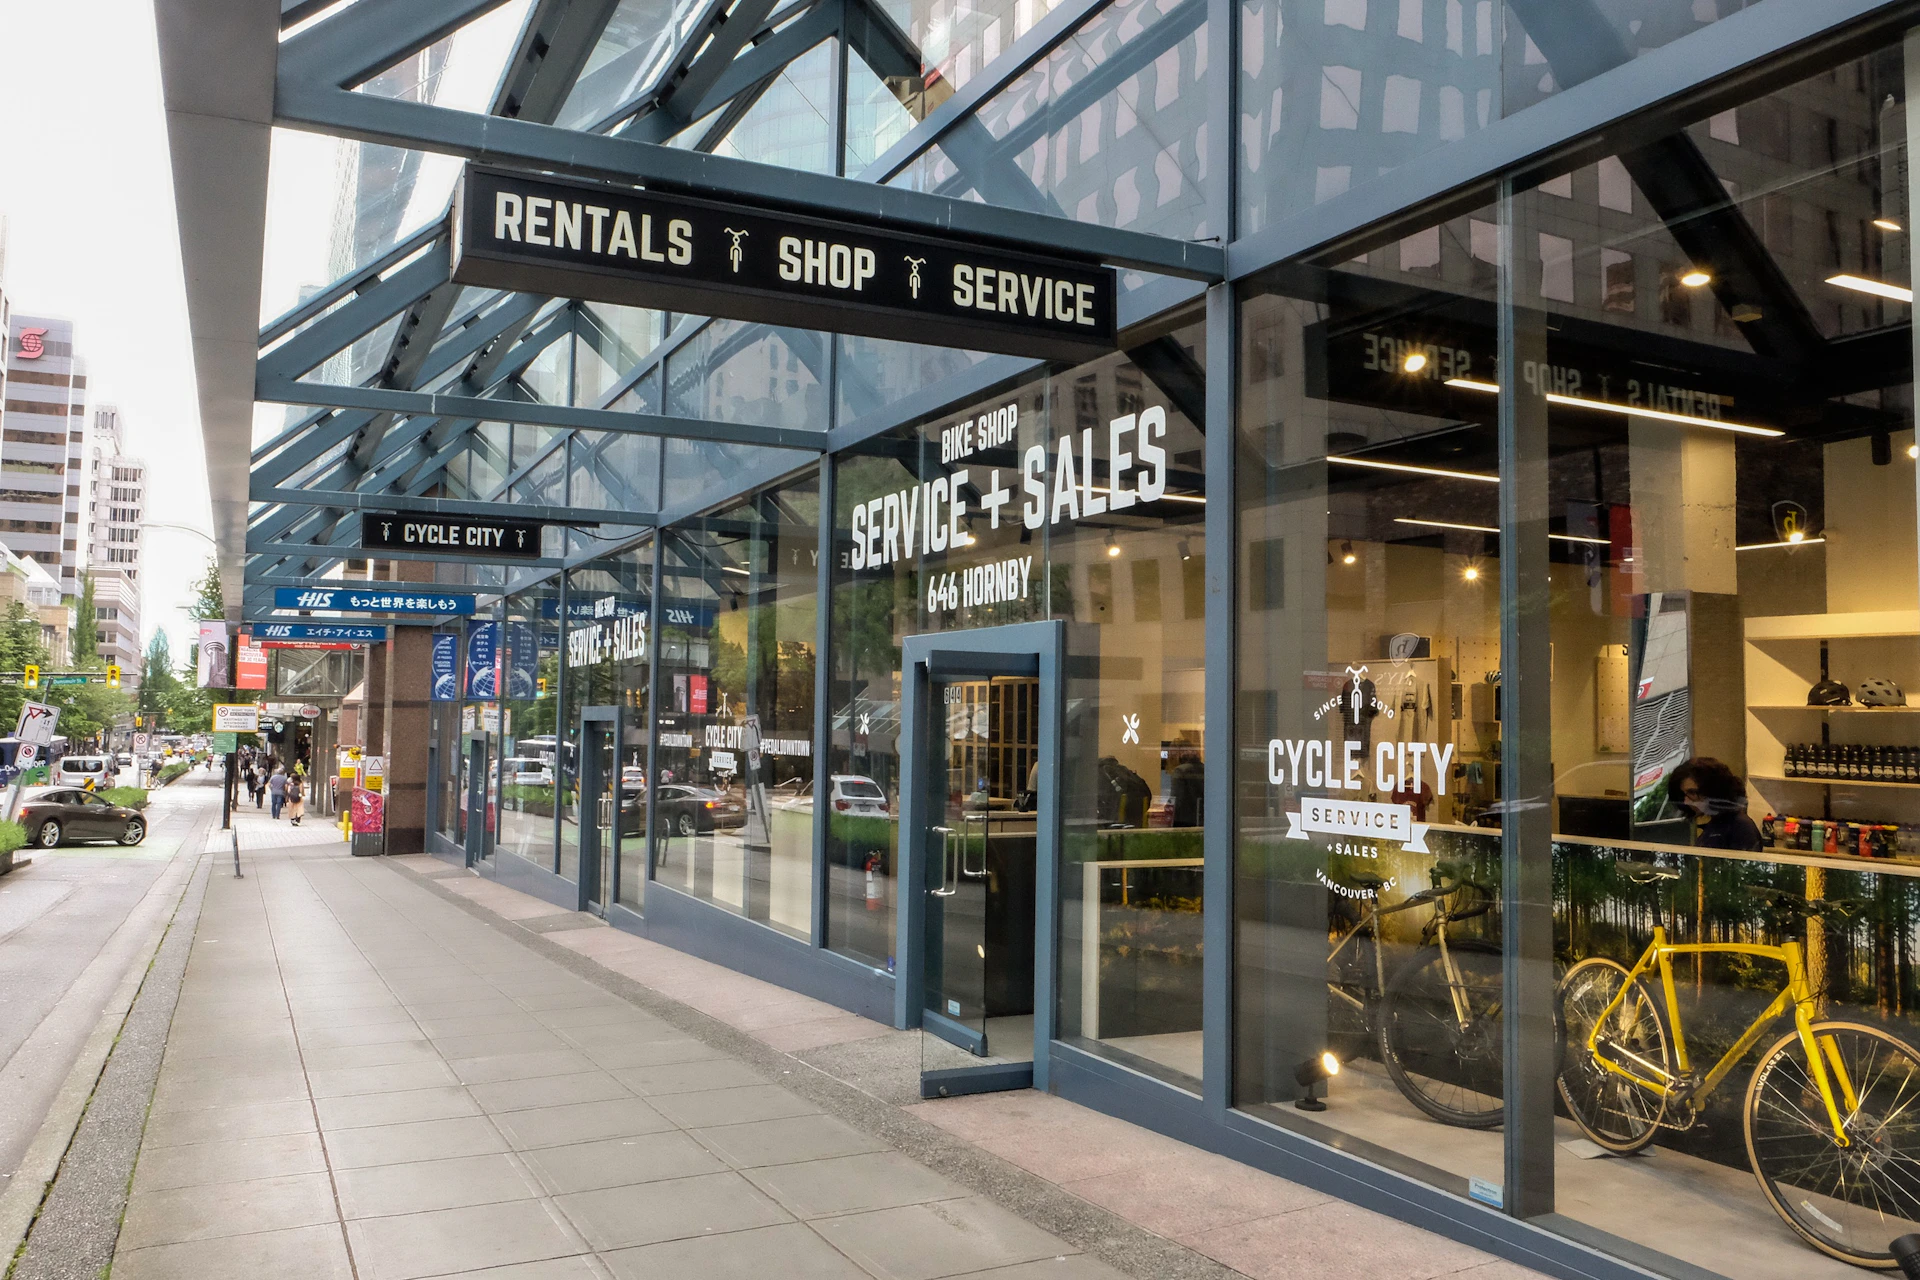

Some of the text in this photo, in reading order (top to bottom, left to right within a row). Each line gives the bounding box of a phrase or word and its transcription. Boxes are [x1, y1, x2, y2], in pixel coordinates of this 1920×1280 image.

[494, 191, 1096, 328] RENTALS SHOP SERVICE
[941, 403, 1018, 465] BIKE SHOP
[851, 404, 1167, 571] SERVICE + SALES
[403, 522, 505, 548] CYCLE CITY
[927, 555, 1033, 613] 646 HORNBY
[296, 591, 335, 608] HIS
[350, 595, 457, 611] もっと世界を楽しもう
[264, 624, 293, 637] HIS
[307, 627, 374, 638] エイチ・アイ・エス
[568, 624, 603, 668] SERVICE
[613, 612, 646, 662] SALES
[1313, 694, 1395, 721] SINCE 2010
[705, 725, 743, 750] CYCLE CITY
[1267, 738, 1454, 796] CYCLE CITY
[1311, 807, 1399, 830] SERVICE
[1383, 876, 1398, 892] BC
[1757, 1059, 1777, 1087] VOLAR
